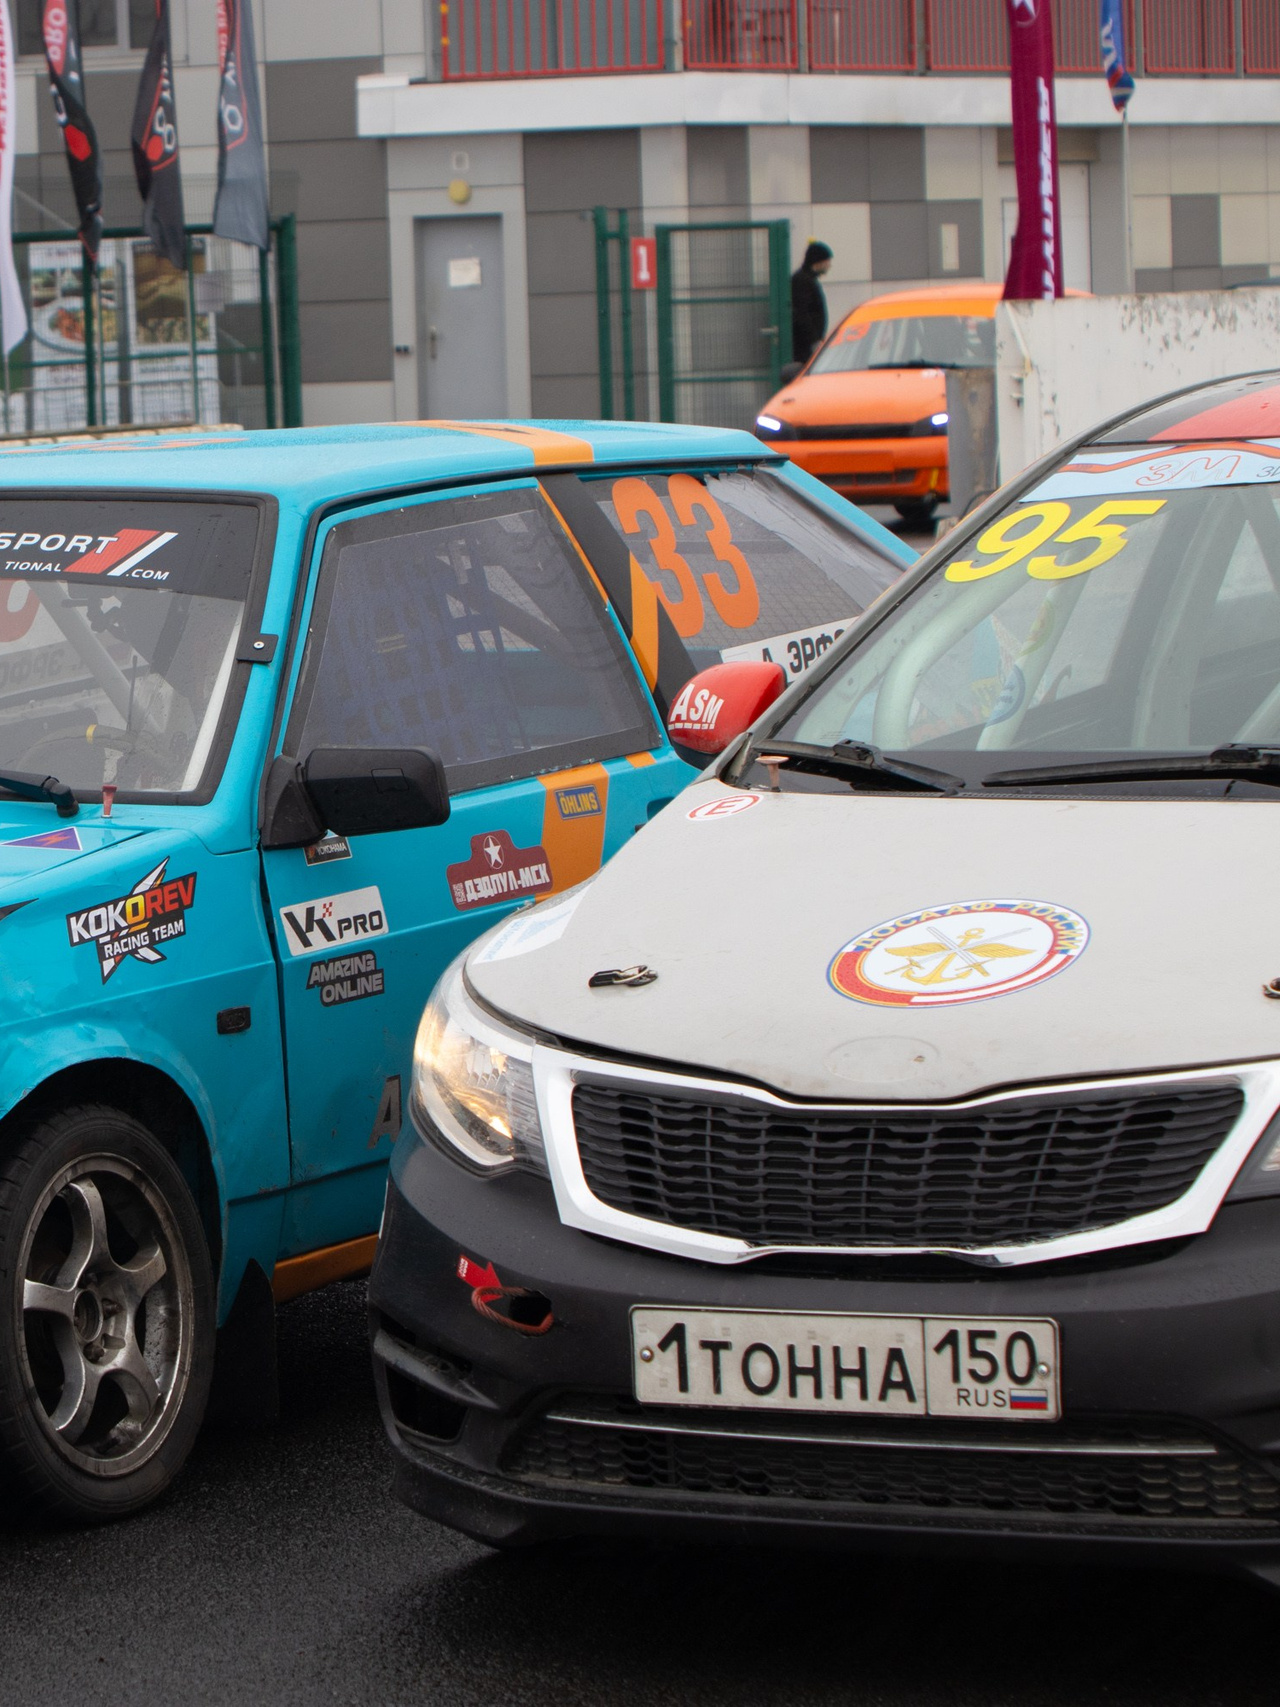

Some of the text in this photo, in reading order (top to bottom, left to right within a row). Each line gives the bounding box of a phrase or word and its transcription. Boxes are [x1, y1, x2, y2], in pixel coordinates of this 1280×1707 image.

[637, 249, 650, 281] 1
[612, 474, 760, 638] 33
[945, 499, 1168, 583] 95
[125, 569, 170, 581] .COM
[671, 683, 724, 725] ASM
[559, 792, 598, 816] ÖHLINS
[464, 862, 551, 903] ДЭДПУЛ-МСК
[70, 877, 195, 944] KOKOREV
[337, 909, 384, 940] PRO
[854, 901, 1085, 951] ДОСААФ РОССИИ
[104, 918, 184, 959] RACING TEAM
[309, 953, 376, 985] AMAZING
[322, 972, 383, 1003] ONLINE
[656, 1322, 1038, 1404] 1ТОННА 150
[957, 1388, 1008, 1410] RUS
